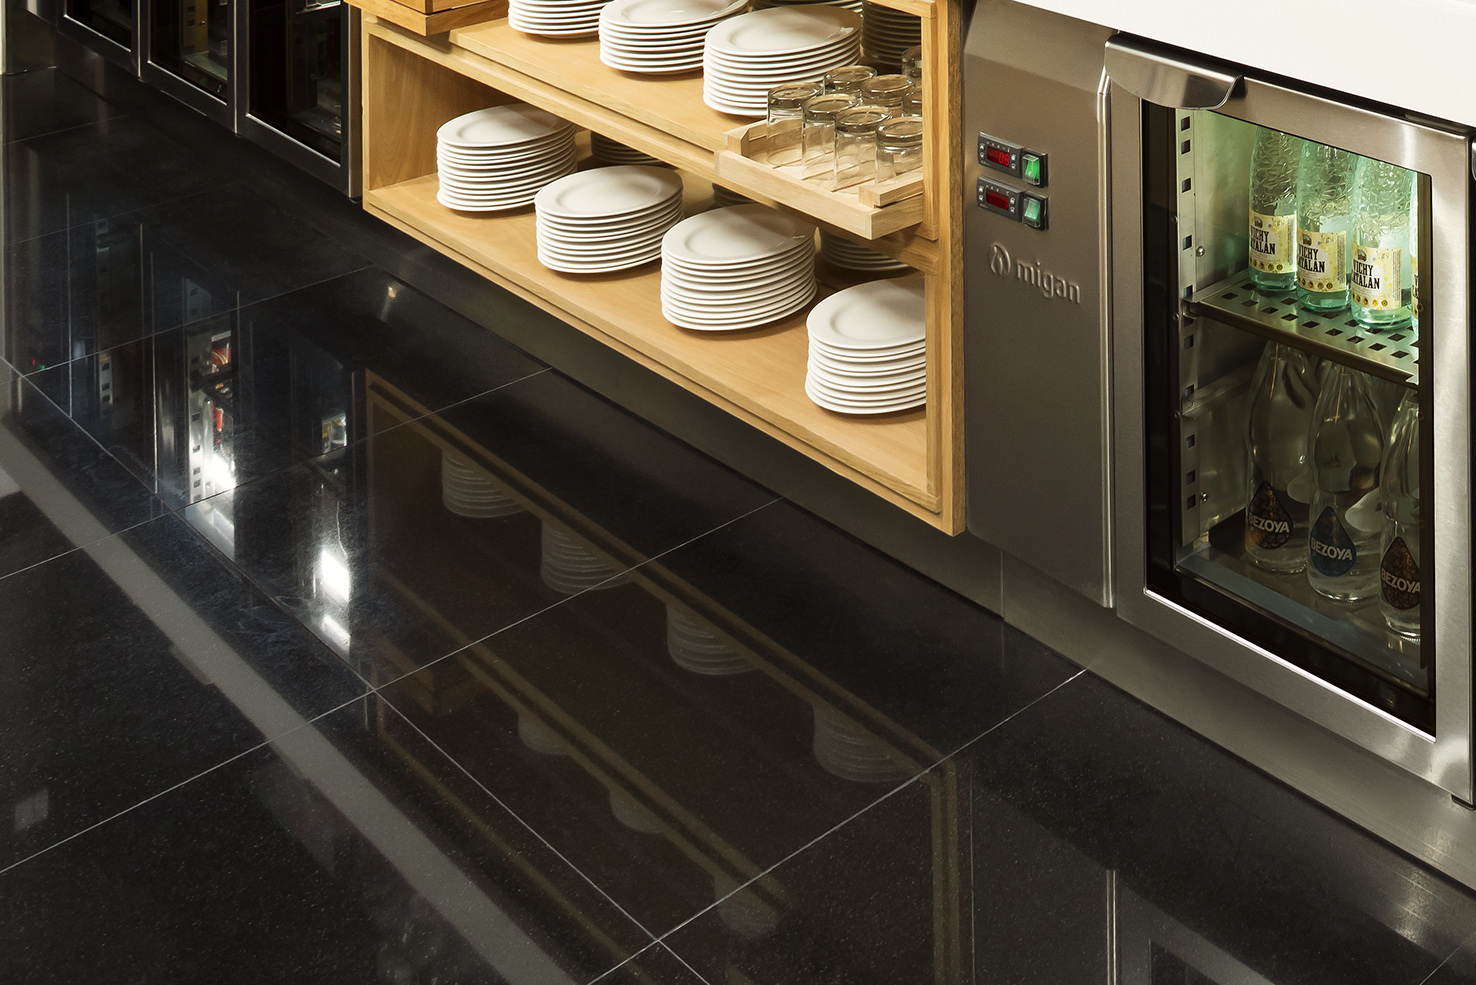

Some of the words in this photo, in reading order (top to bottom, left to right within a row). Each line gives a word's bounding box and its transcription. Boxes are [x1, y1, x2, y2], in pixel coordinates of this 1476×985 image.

[1016, 259, 1082, 305] migan
[1310, 537, 1353, 561] BEZOYA
[1381, 567, 1421, 594] BEZOYA
